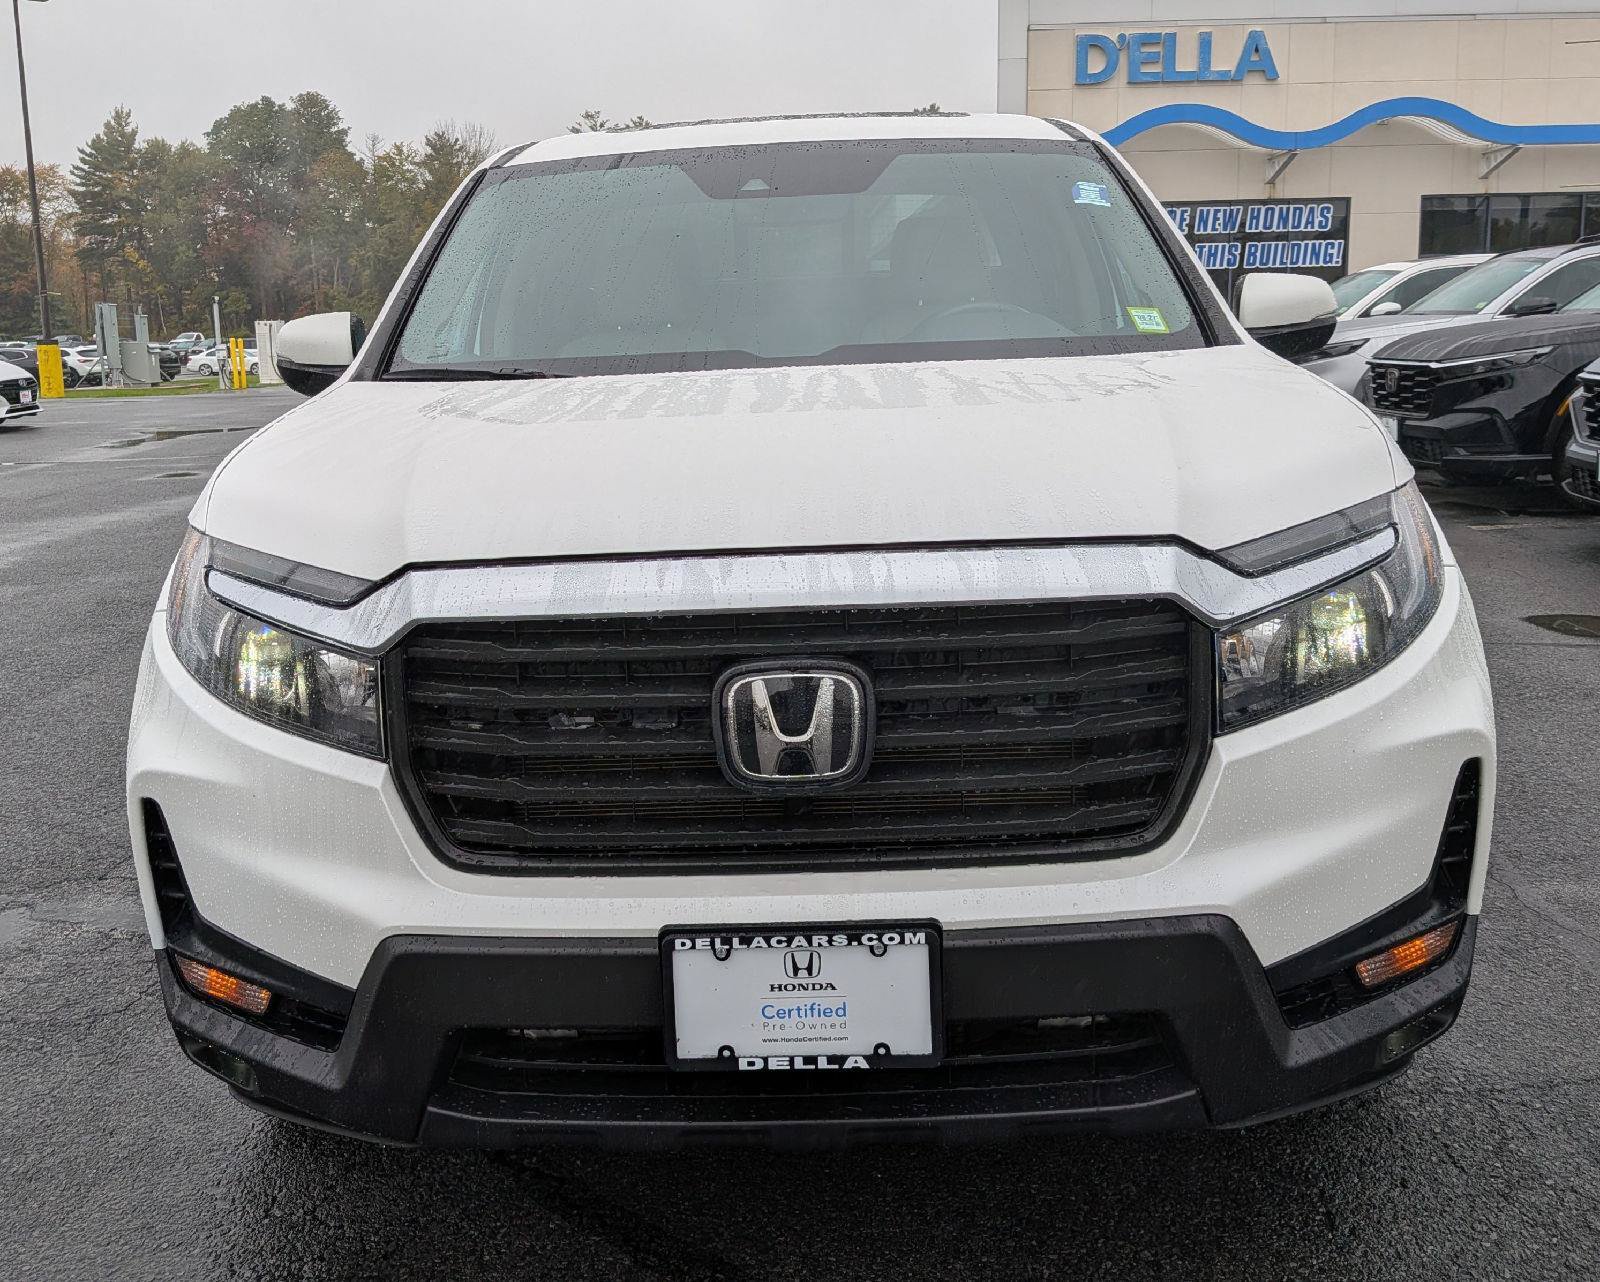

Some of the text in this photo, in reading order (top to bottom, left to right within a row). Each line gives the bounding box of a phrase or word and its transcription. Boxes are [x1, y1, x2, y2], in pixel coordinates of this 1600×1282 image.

[1075, 29, 1280, 86] D'ELLA
[1194, 205, 1243, 235] NEW
[1245, 203, 1333, 233] HONDAS
[1195, 239, 1345, 270] THIS BUILDING!
[674, 932, 926, 951] DELLACARS.COM
[768, 982, 838, 992] HONDA
[761, 1002, 847, 1020] Certified
[762, 1020, 847, 1031] Pre-Owned
[762, 1035, 849, 1043] www.HondaCertified.com
[738, 1055, 870, 1071] DELLA
